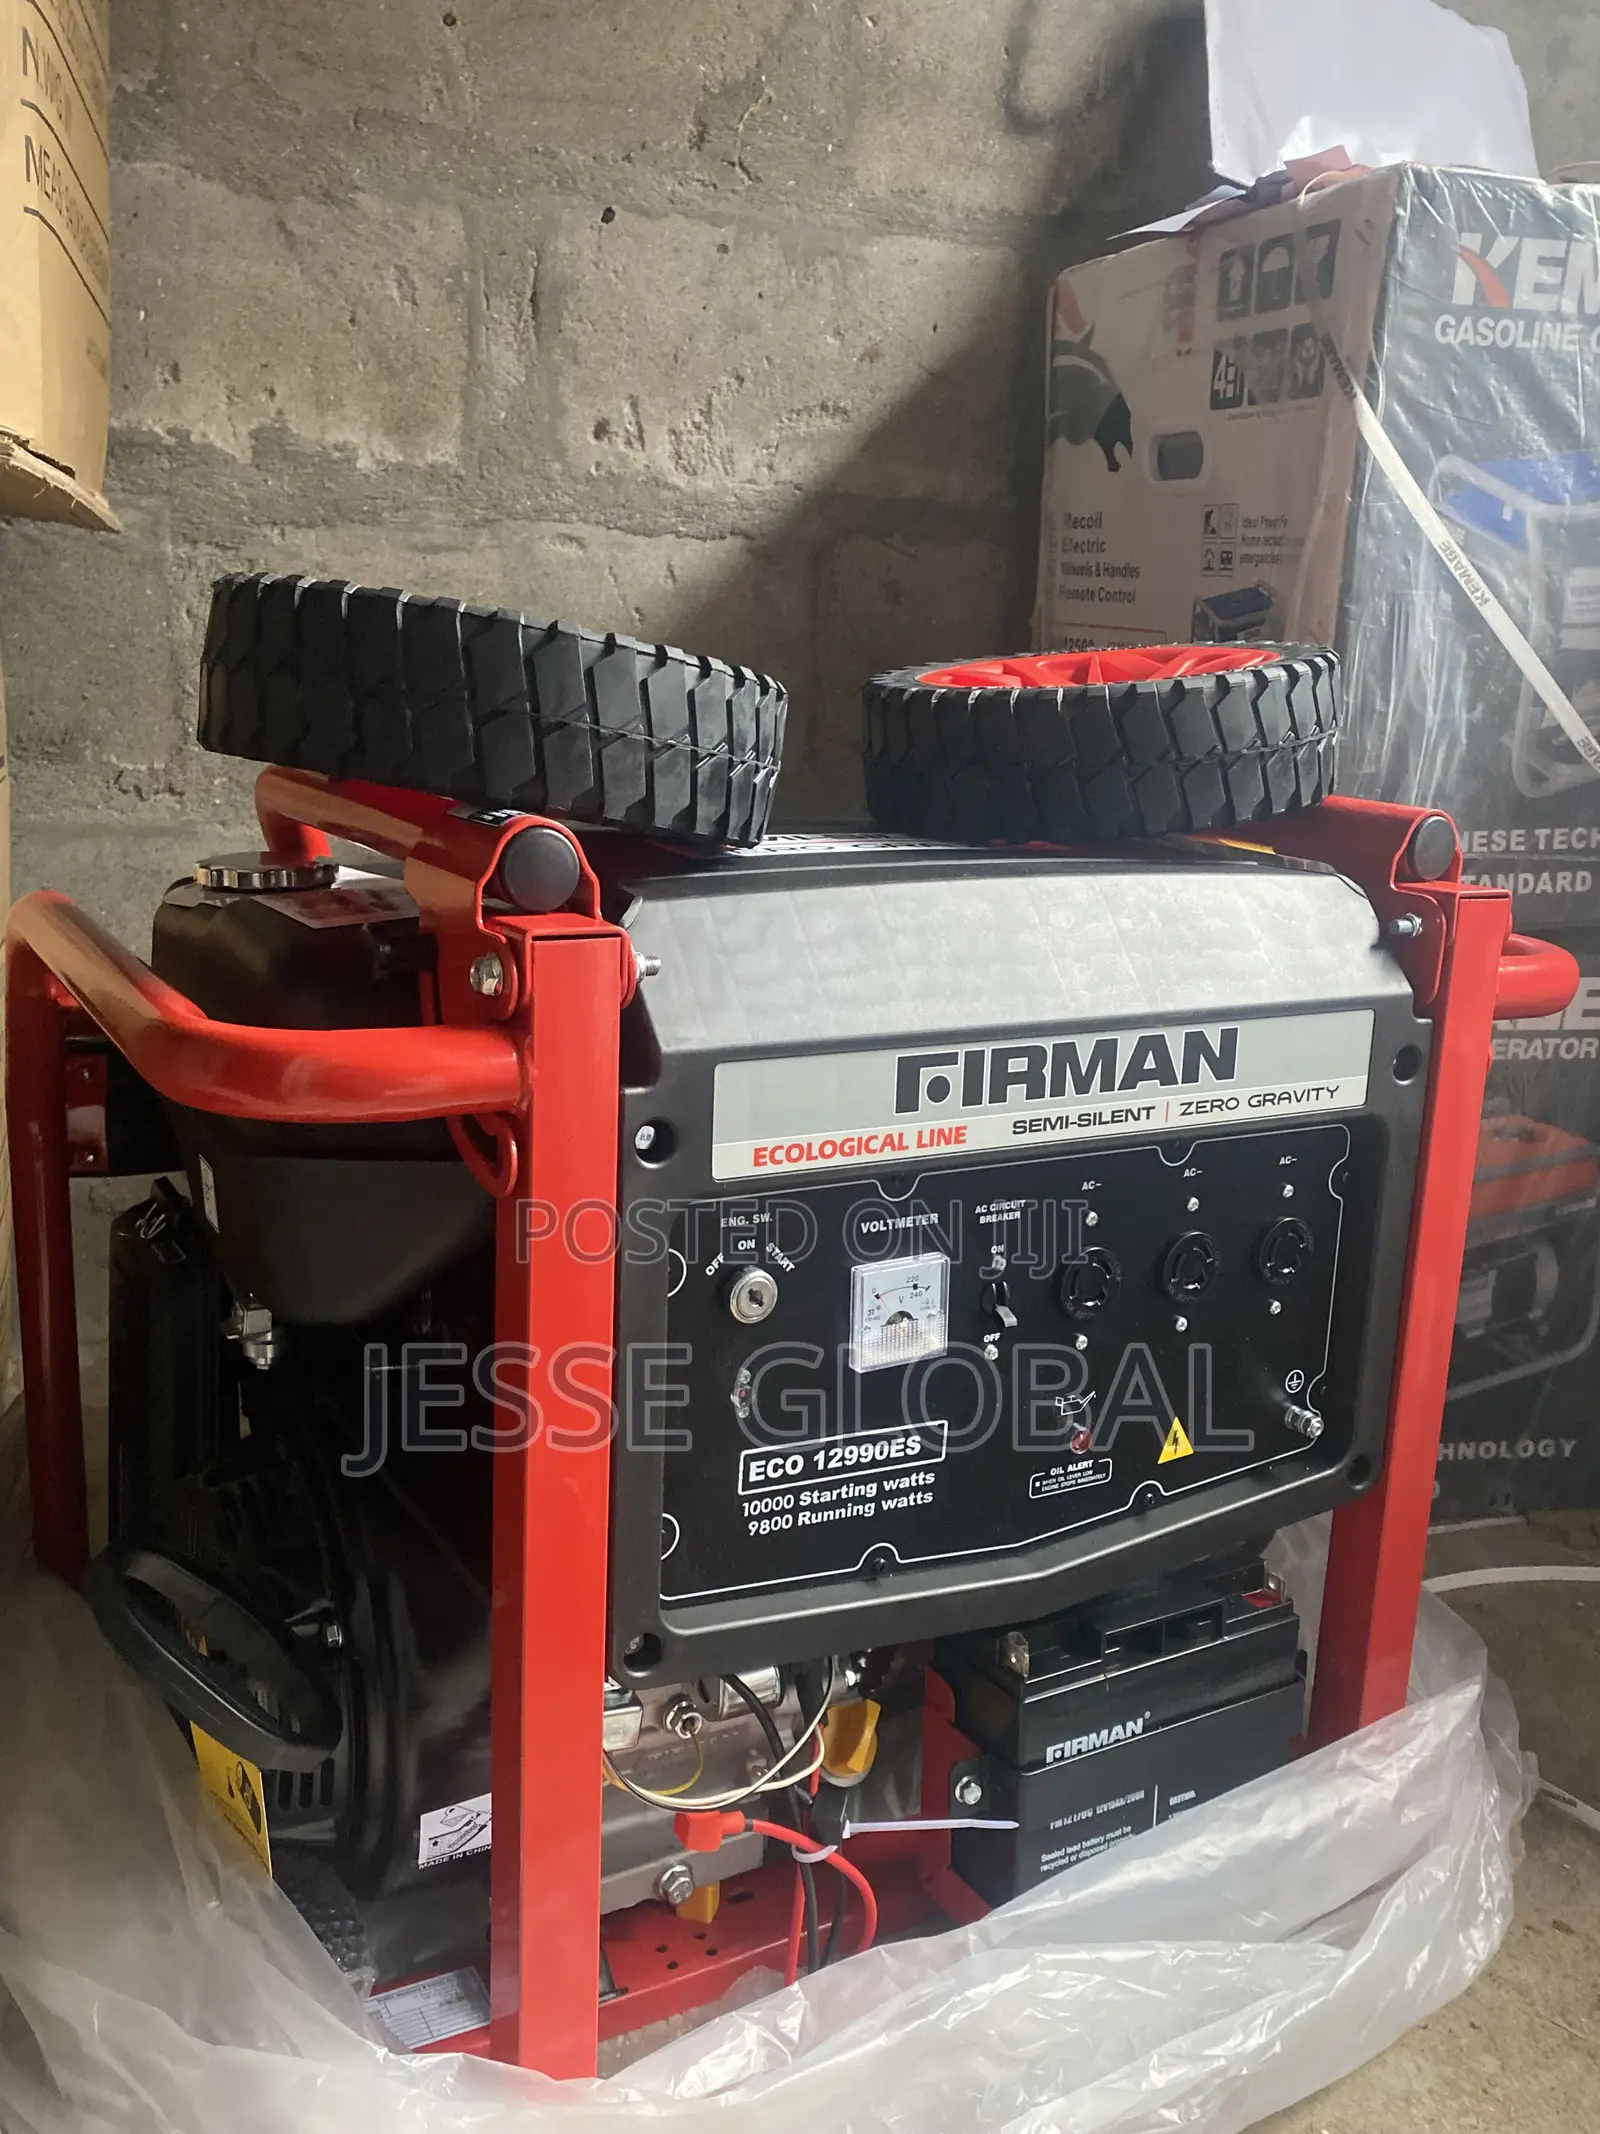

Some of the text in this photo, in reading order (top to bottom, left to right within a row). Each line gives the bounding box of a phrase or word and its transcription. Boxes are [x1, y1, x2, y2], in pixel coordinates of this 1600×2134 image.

[1434, 313, 1581, 350] GASOLINE
[1061, 537, 1106, 553] Electric
[1097, 586, 1136, 603] Control
[1461, 870, 1593, 895] TANDARD
[1492, 1037, 1600, 1060] ERATOR
[894, 1026, 1240, 1115] FIRMAN
[1012, 1085, 1340, 1135] SEMI-SILENT ZERO GRAVITY
[752, 1125, 968, 1167] ECOLOGICAL LINE
[975, 1199, 1027, 1214] AC CIRCUIT
[979, 1211, 1021, 1224] BREAKER
[720, 1212, 773, 1228] ENG. SW.
[860, 1213, 939, 1234] VOLTMETER
[737, 1238, 756, 1251] ON
[990, 1245, 1005, 1255] ON
[704, 1252, 725, 1276] OFF
[765, 1242, 796, 1273] START
[906, 1274, 920, 1284] 220
[909, 1290, 923, 1299] 240
[983, 1332, 1001, 1343] OFF
[748, 1435, 922, 1482] ECO 12990ES
[1049, 1459, 1094, 1476] OIL ALERT
[741, 1471, 936, 1517] 10000 Starting watts
[747, 1490, 934, 1536] 9800 Running watts
[1046, 1717, 1144, 1764] FIRMAN
[419, 1844, 492, 1870] MADE IN CHIN
[1040, 1847, 1065, 1863] Sealed
